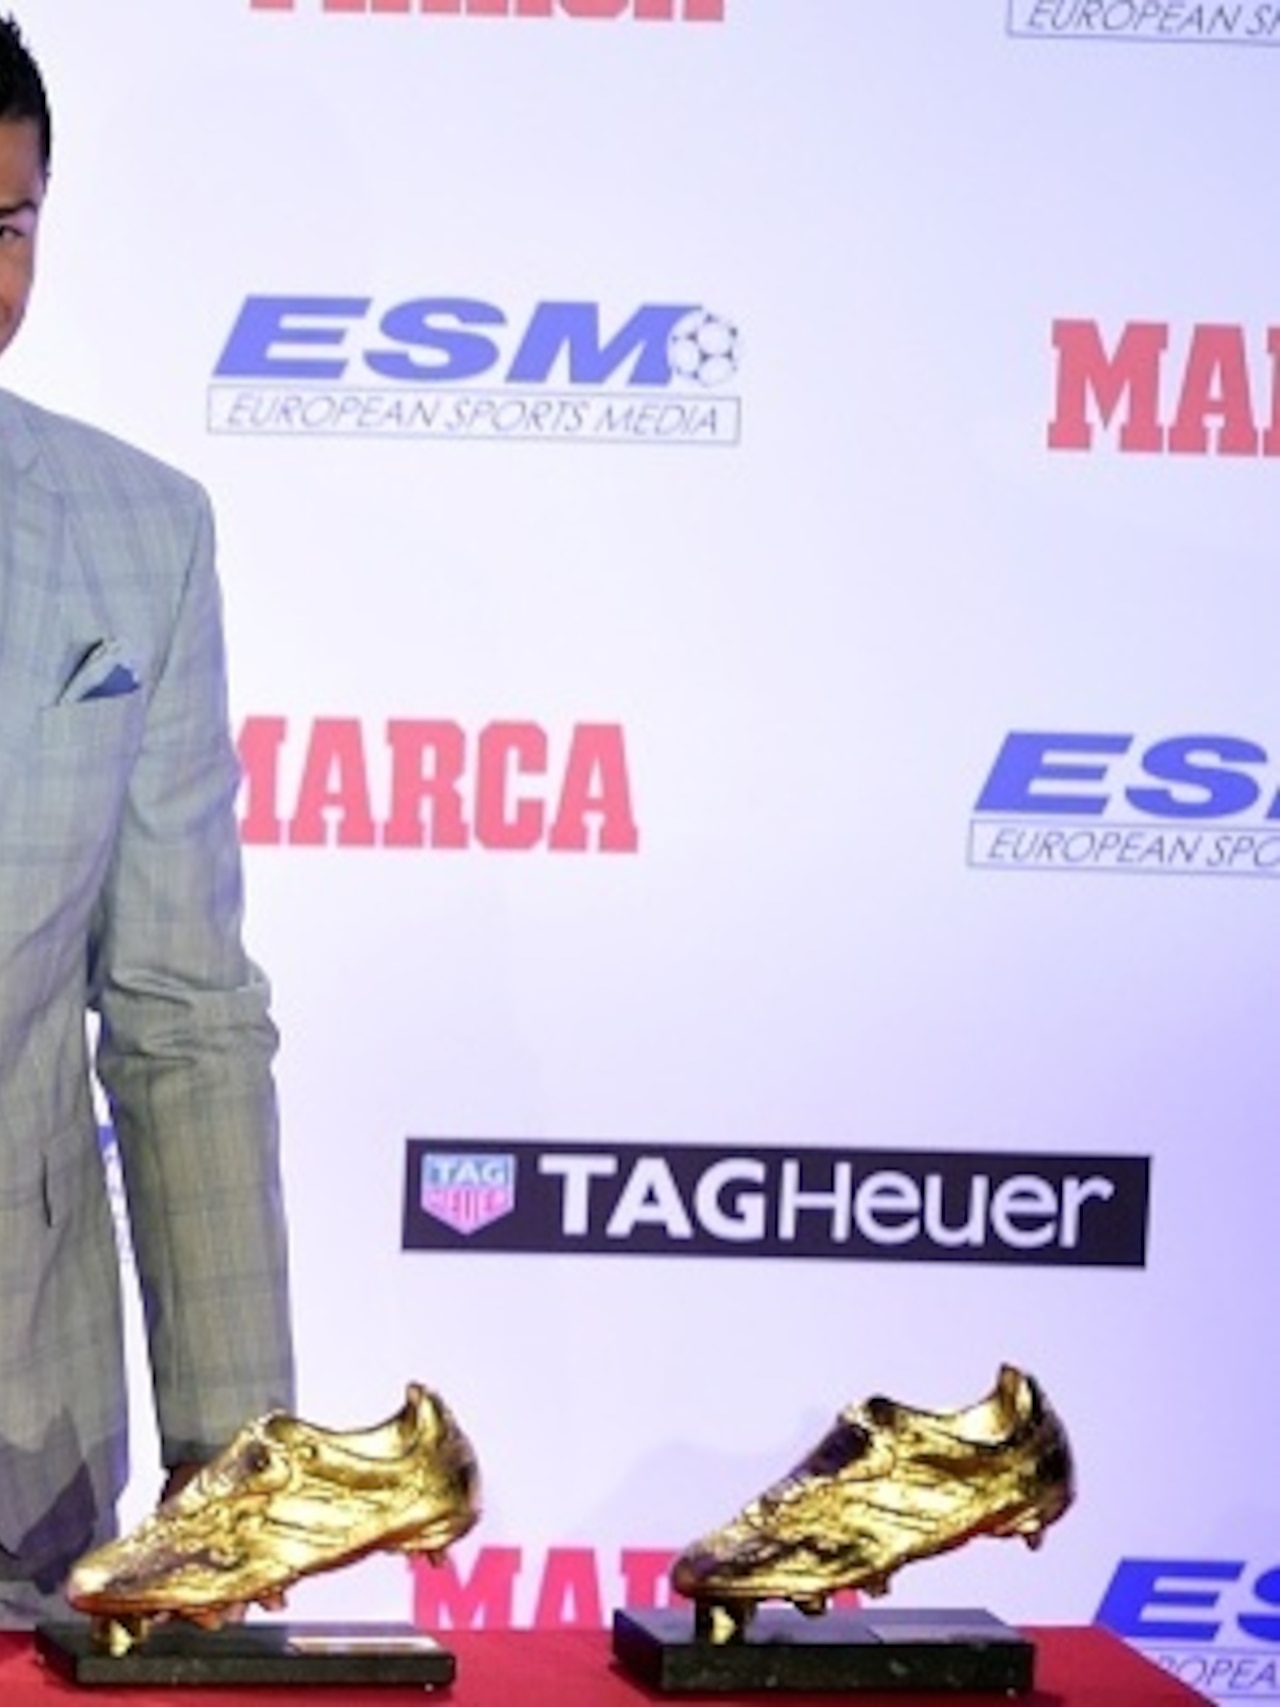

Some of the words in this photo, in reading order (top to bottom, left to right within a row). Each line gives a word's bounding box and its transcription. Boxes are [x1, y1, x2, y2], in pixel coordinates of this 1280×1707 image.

[211, 295, 704, 387] ESM
[226, 392, 440, 428] EUROPEAN
[445, 395, 590, 433] SPORTS
[593, 400, 719, 436] MEDIA
[1047, 319, 1280, 457] MA
[973, 731, 1280, 820] ES
[988, 827, 1202, 864] EUROPEAN
[431, 1160, 507, 1184] TAG
